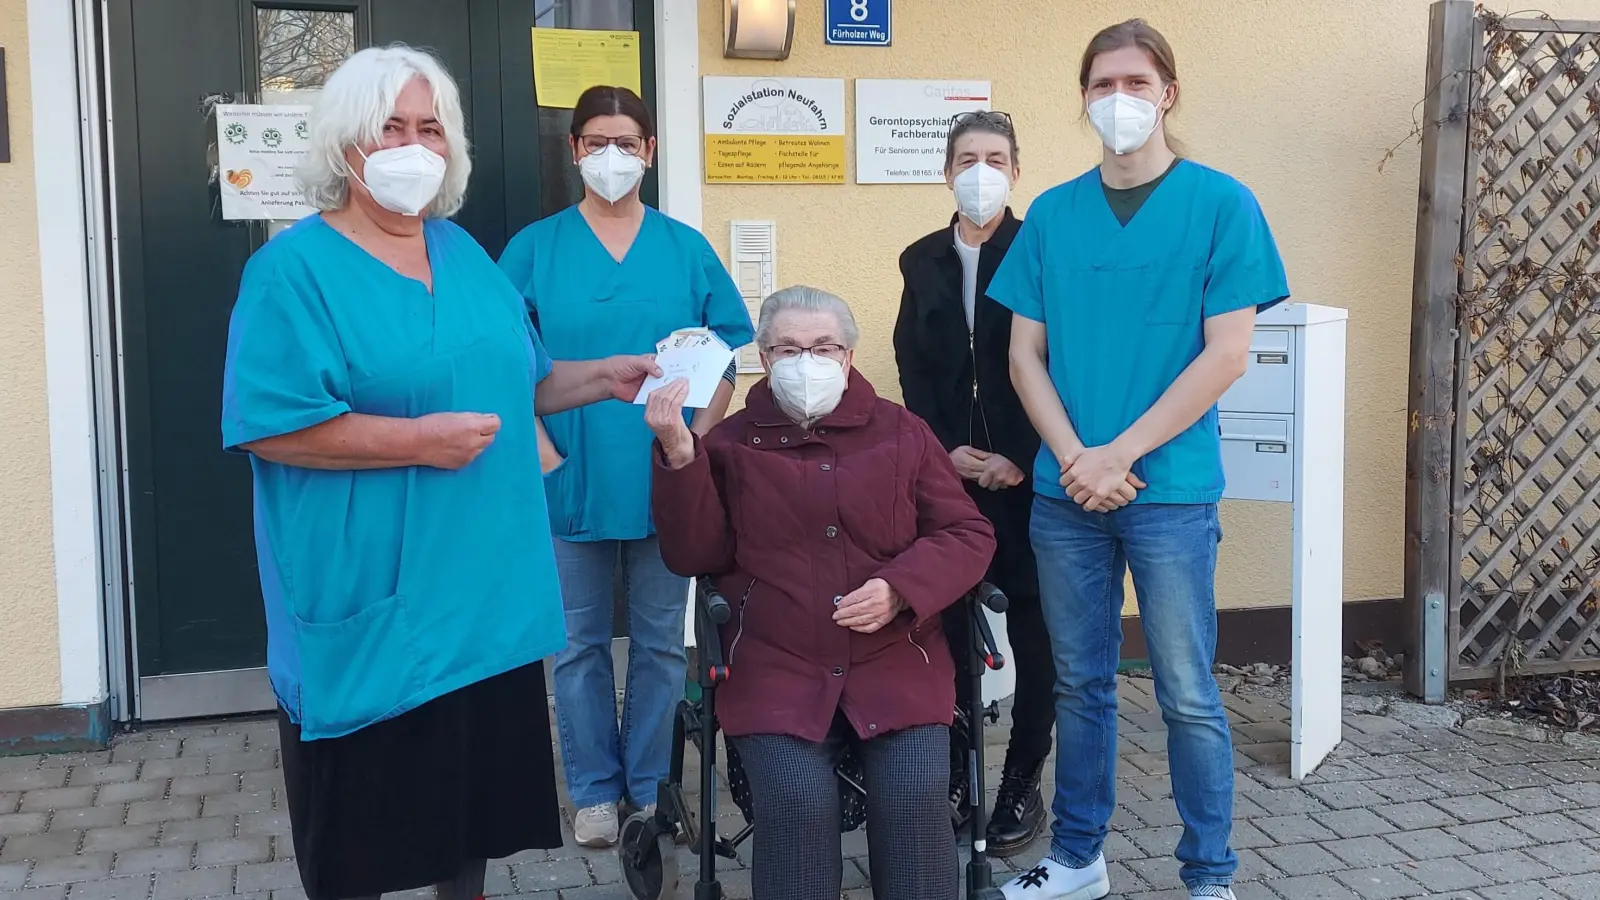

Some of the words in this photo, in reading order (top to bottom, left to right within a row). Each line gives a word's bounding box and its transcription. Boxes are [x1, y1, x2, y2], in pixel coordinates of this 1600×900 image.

[850, 0, 868, 22] 8
[832, 29, 868, 39] Fürholzer
[869, 30, 886, 41] Weg
[924, 84, 972, 97] Caritas
[722, 87, 785, 130] Sozialstation
[787, 89, 828, 130] Neufahrn
[869, 116, 951, 128] Gerontopsychiat
[891, 129, 950, 138] Fachberatu
[748, 139, 767, 147] Pflege
[718, 150, 752, 158] Tagespflege
[874, 146, 887, 154] Für
[888, 146, 920, 154] Senioren
[778, 161, 806, 170] pflegende
